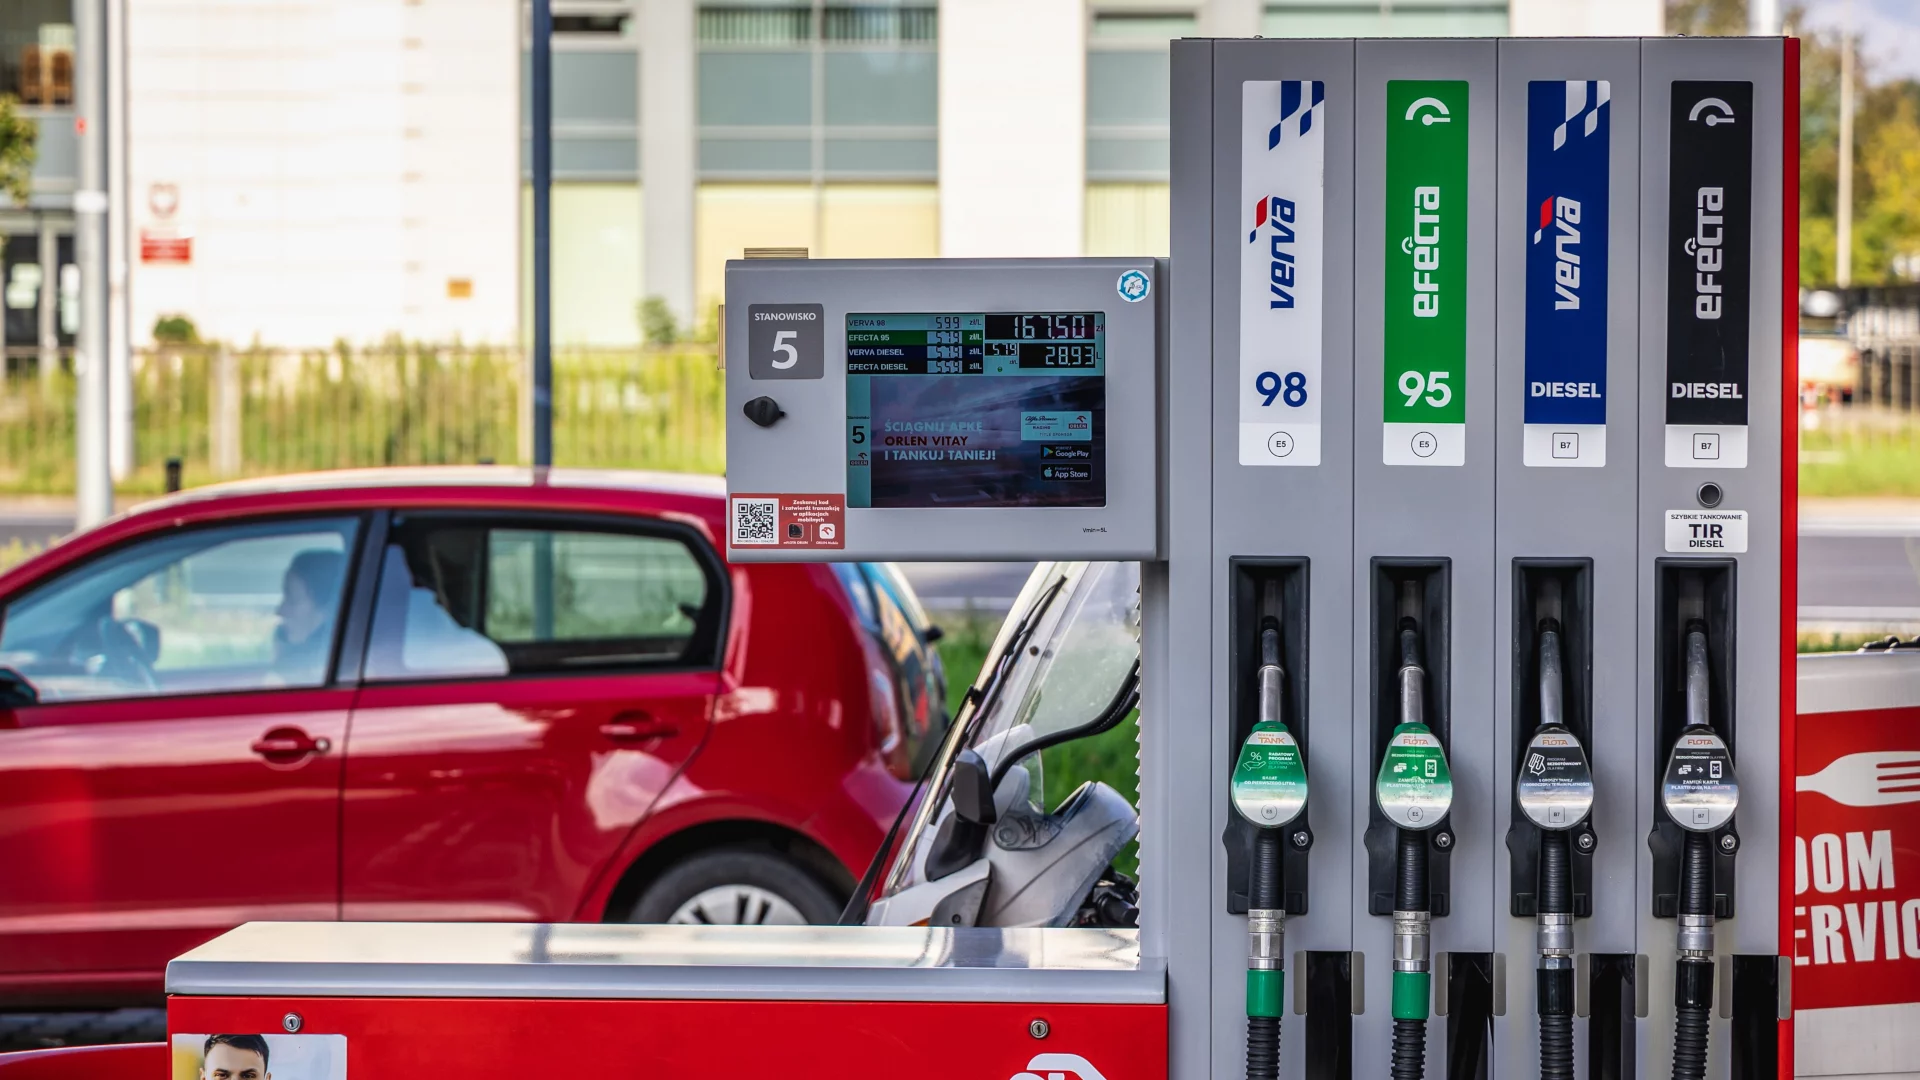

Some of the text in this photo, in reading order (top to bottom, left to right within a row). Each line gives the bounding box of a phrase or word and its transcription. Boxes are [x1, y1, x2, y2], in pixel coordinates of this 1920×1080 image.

[1270, 196, 1295, 310] verva
[1555, 196, 1581, 311] verva
[754, 312, 817, 321] STANOWISKO
[848, 319, 886, 327] VERVA 98
[848, 333, 890, 341] EFECTA 95
[772, 330, 798, 370] 5
[848, 348, 904, 356] VERVA DIESEL
[848, 363, 909, 371] EFECTA DIESEL
[1255, 371, 1308, 408] 98
[1398, 370, 1452, 408] 95
[1531, 382, 1601, 398] DIESEL
[1671, 382, 1743, 399] DIESEL
[884, 418, 945, 434] ŚCIĄGNIJ
[852, 425, 866, 445] 5
[884, 436, 969, 446] ORLEN VITAY
[1276, 440, 1287, 448] E5
[1419, 440, 1429, 448] E5
[884, 450, 997, 461] I TANKUJ TANIEJ!
[1055, 450, 1089, 458] Google Play
[1054, 471, 1069, 479] App
[1688, 524, 1723, 538] TIR
